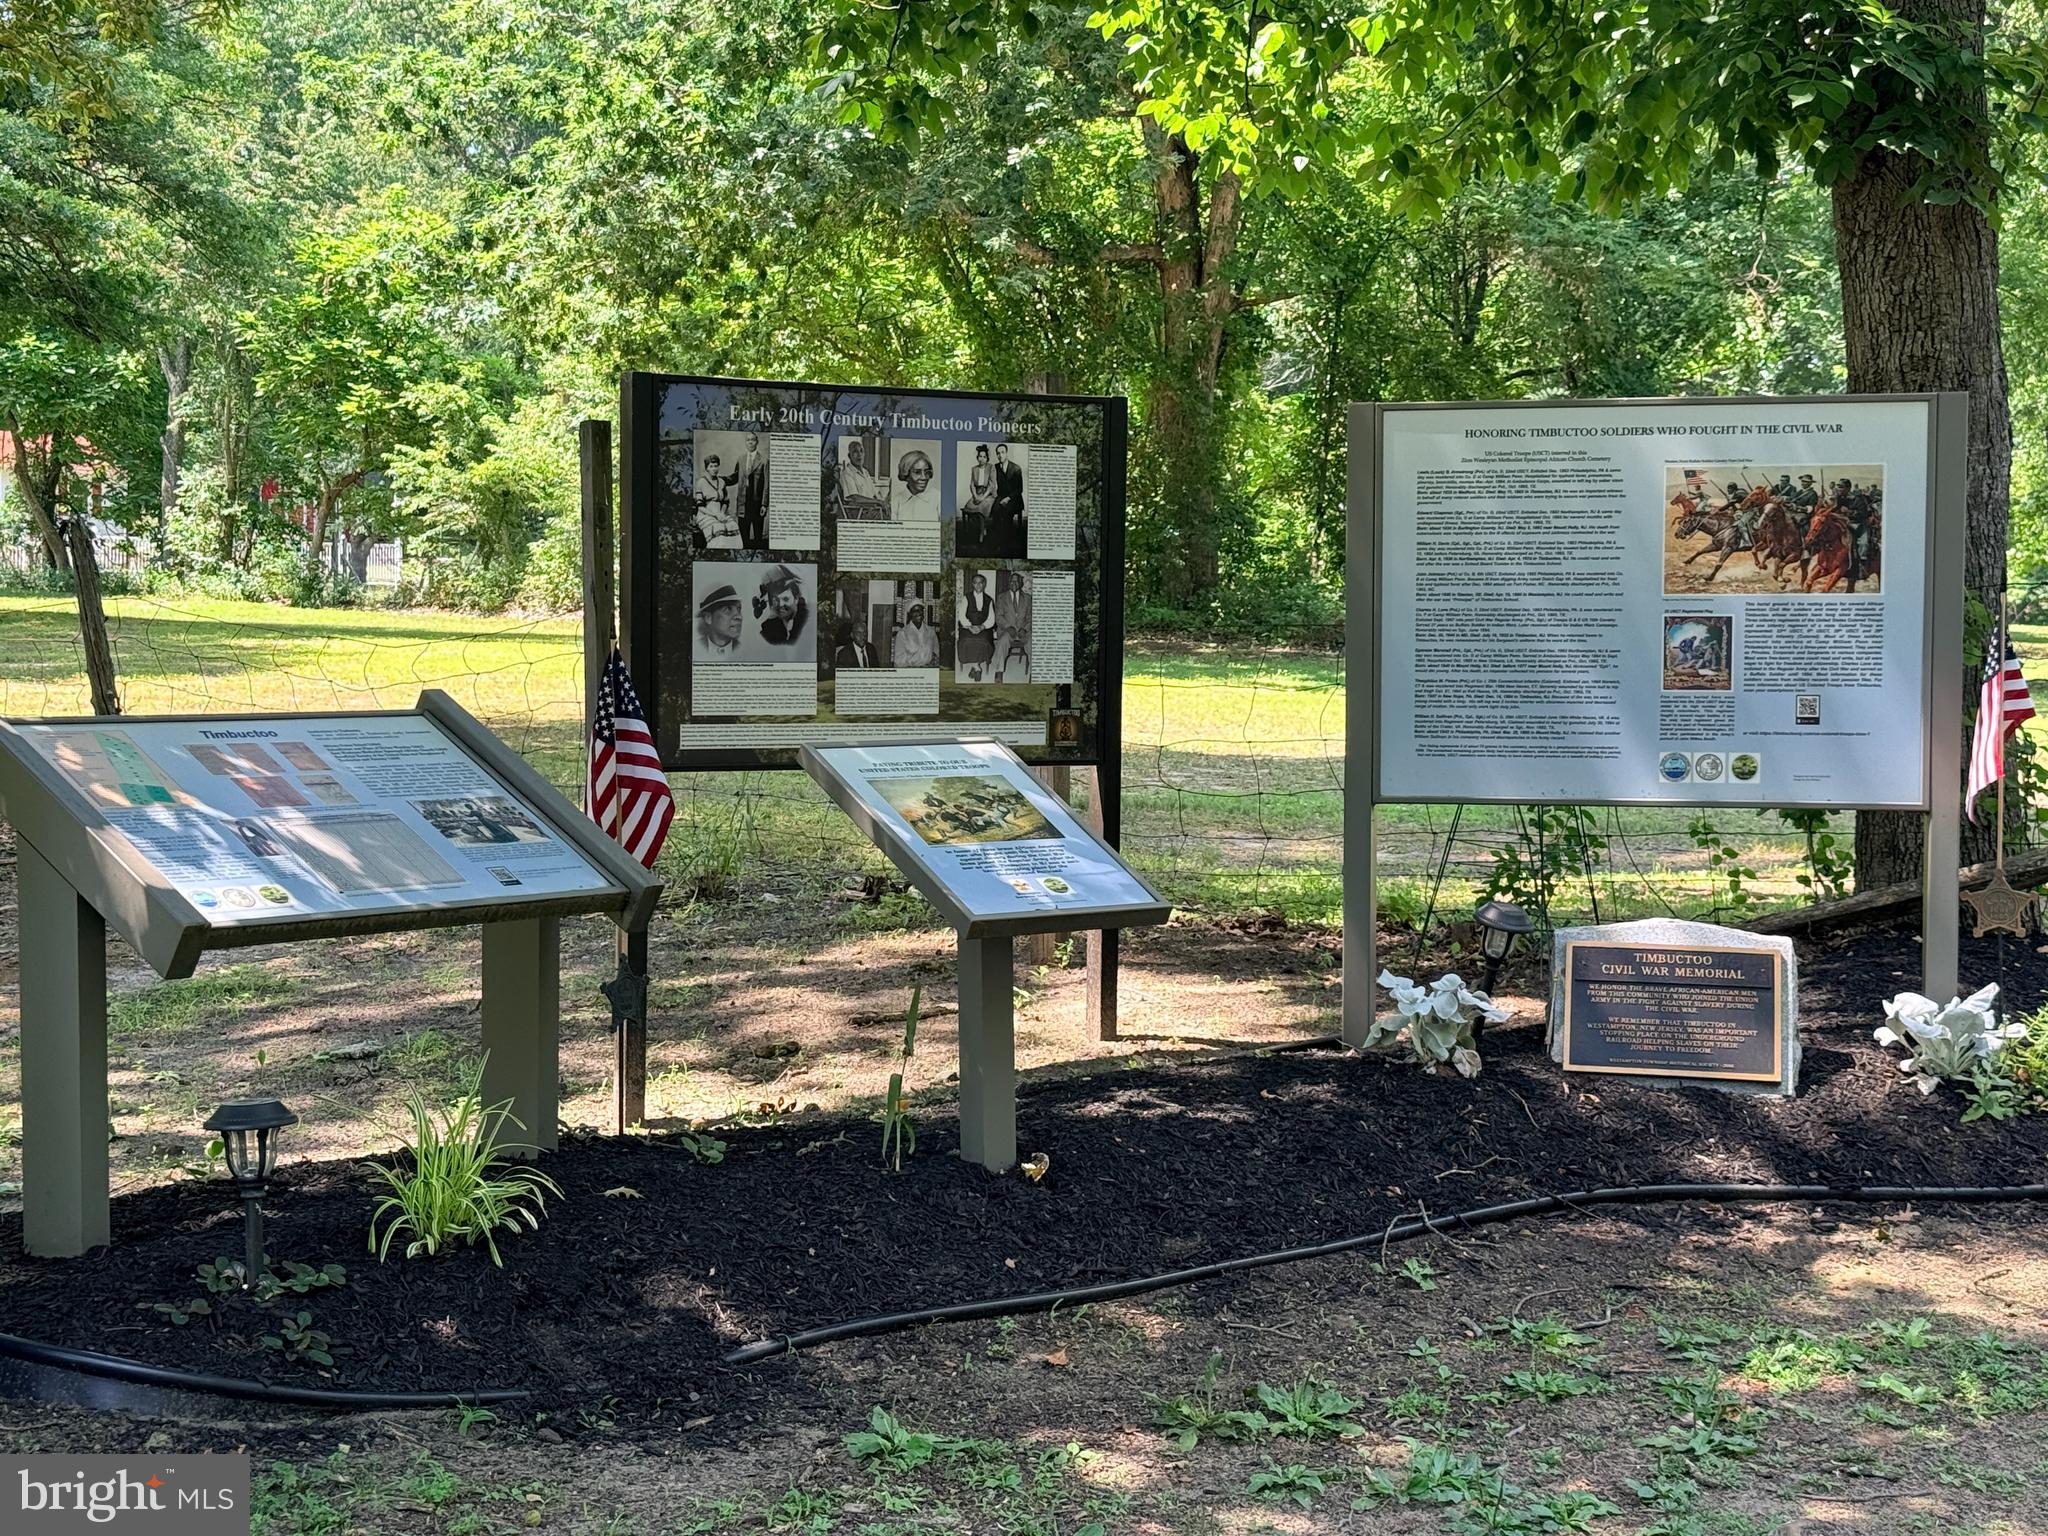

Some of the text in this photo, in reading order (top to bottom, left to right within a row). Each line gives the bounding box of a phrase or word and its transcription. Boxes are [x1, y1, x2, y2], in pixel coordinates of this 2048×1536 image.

[729, 404, 1042, 435] Early 20th Century Timbuctoo Pioneers
[1465, 423, 1843, 438] HONORING TIMBUCTOO SOLDIERS WHO FOUGHT IN THE CIVIL WAR
[199, 730, 278, 739] Timbuctoo
[1633, 952, 1713, 965] TIMBUCTOO
[1601, 964, 1745, 979] CIVIL WAR MEMORIAL
[1626, 991, 1671, 999] COMMUNITY
[1669, 987, 1740, 996] AFRICAN-AMERICAN
[1684, 1020, 1726, 1028] TIMBUCTOO
[1600, 1029, 1635, 1037] STOPPING
[1690, 1034, 1745, 1042] UNDERGROUND
